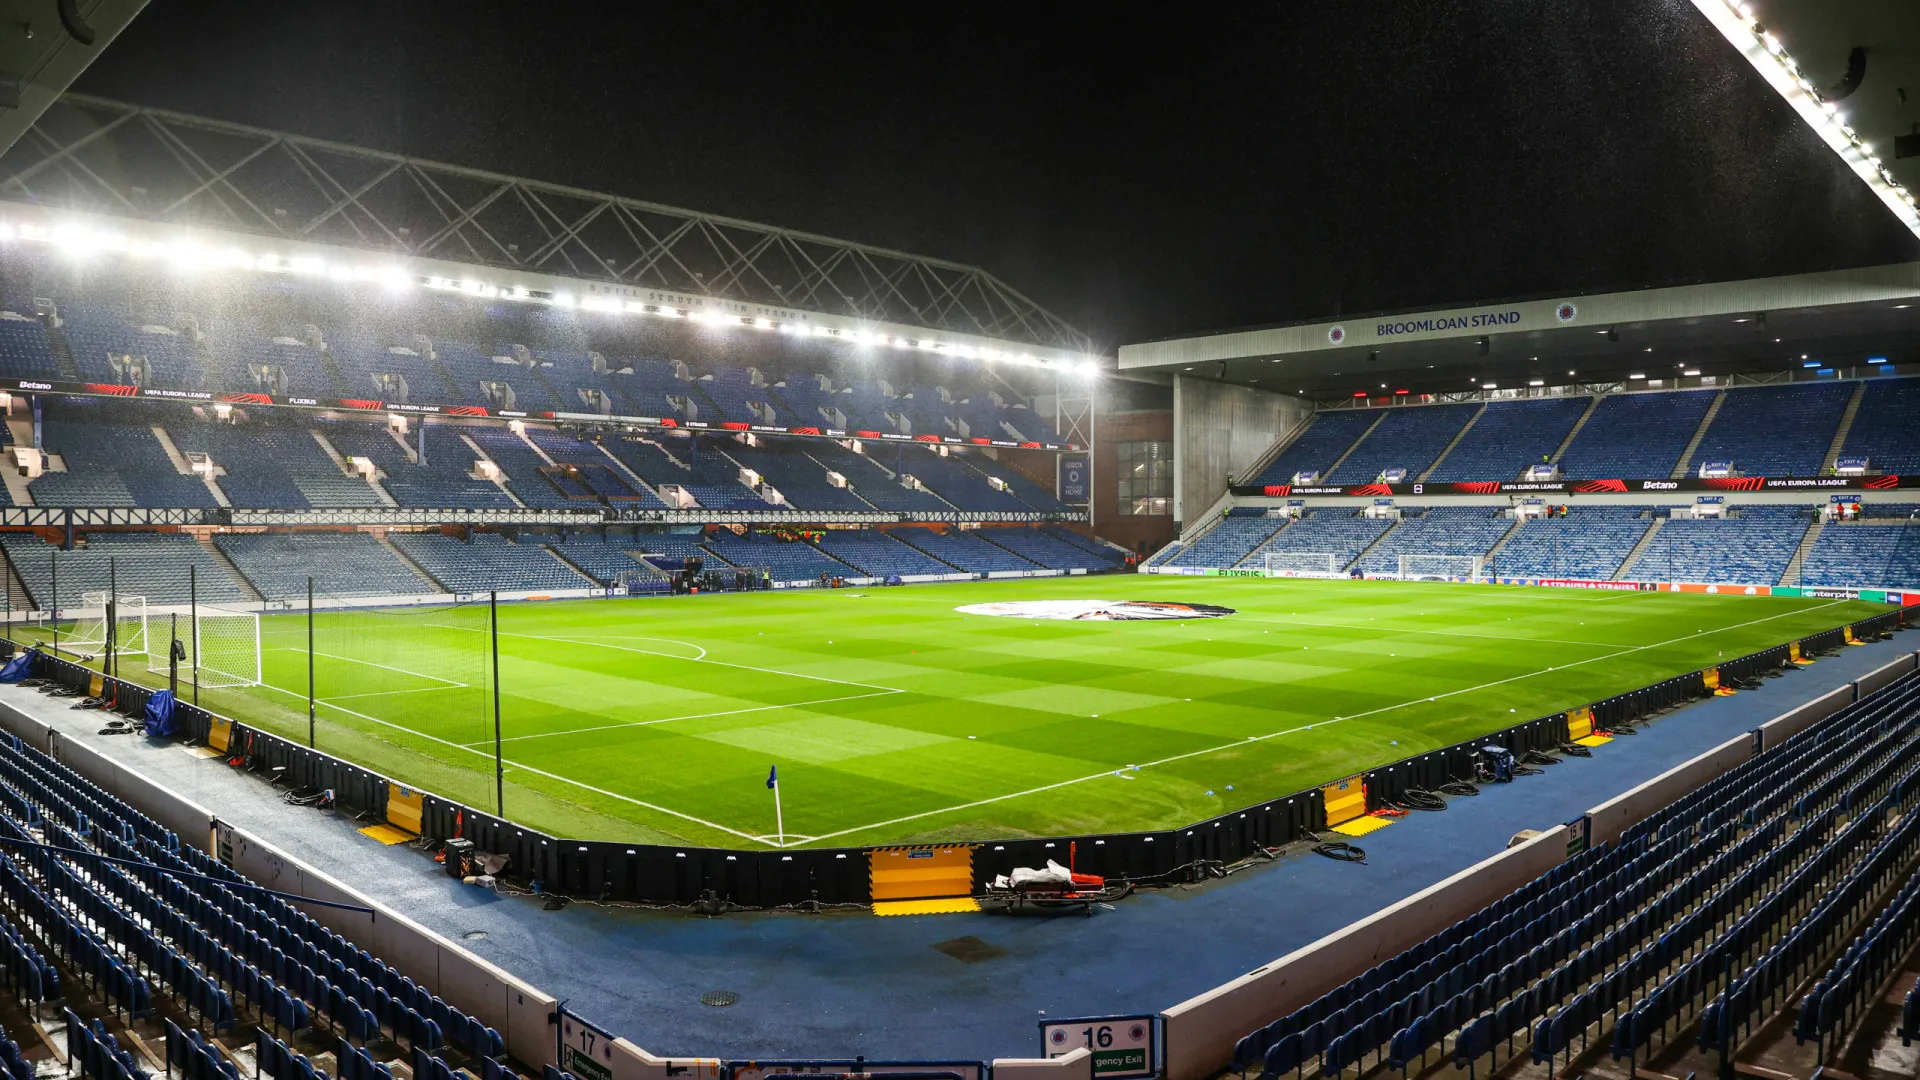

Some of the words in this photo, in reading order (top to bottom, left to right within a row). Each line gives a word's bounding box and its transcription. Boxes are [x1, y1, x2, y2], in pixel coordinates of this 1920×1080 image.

[650, 292, 702, 306] STRUTH
[757, 308, 795, 319] STAND
[1377, 317, 1468, 336] BROOMLOAN
[1471, 311, 1520, 327] STAND
[19, 381, 52, 390] Betano
[1643, 481, 1678, 489] Betano
[1550, 581, 1587, 589] STRAUSS
[1802, 590, 1859, 600] enterprise
[580, 1029, 596, 1055] 17
[1082, 1025, 1114, 1049] 16
[574, 1056, 601, 1080] Emergency
[1095, 1057, 1124, 1067] gency
[1125, 1055, 1143, 1064] Exit
